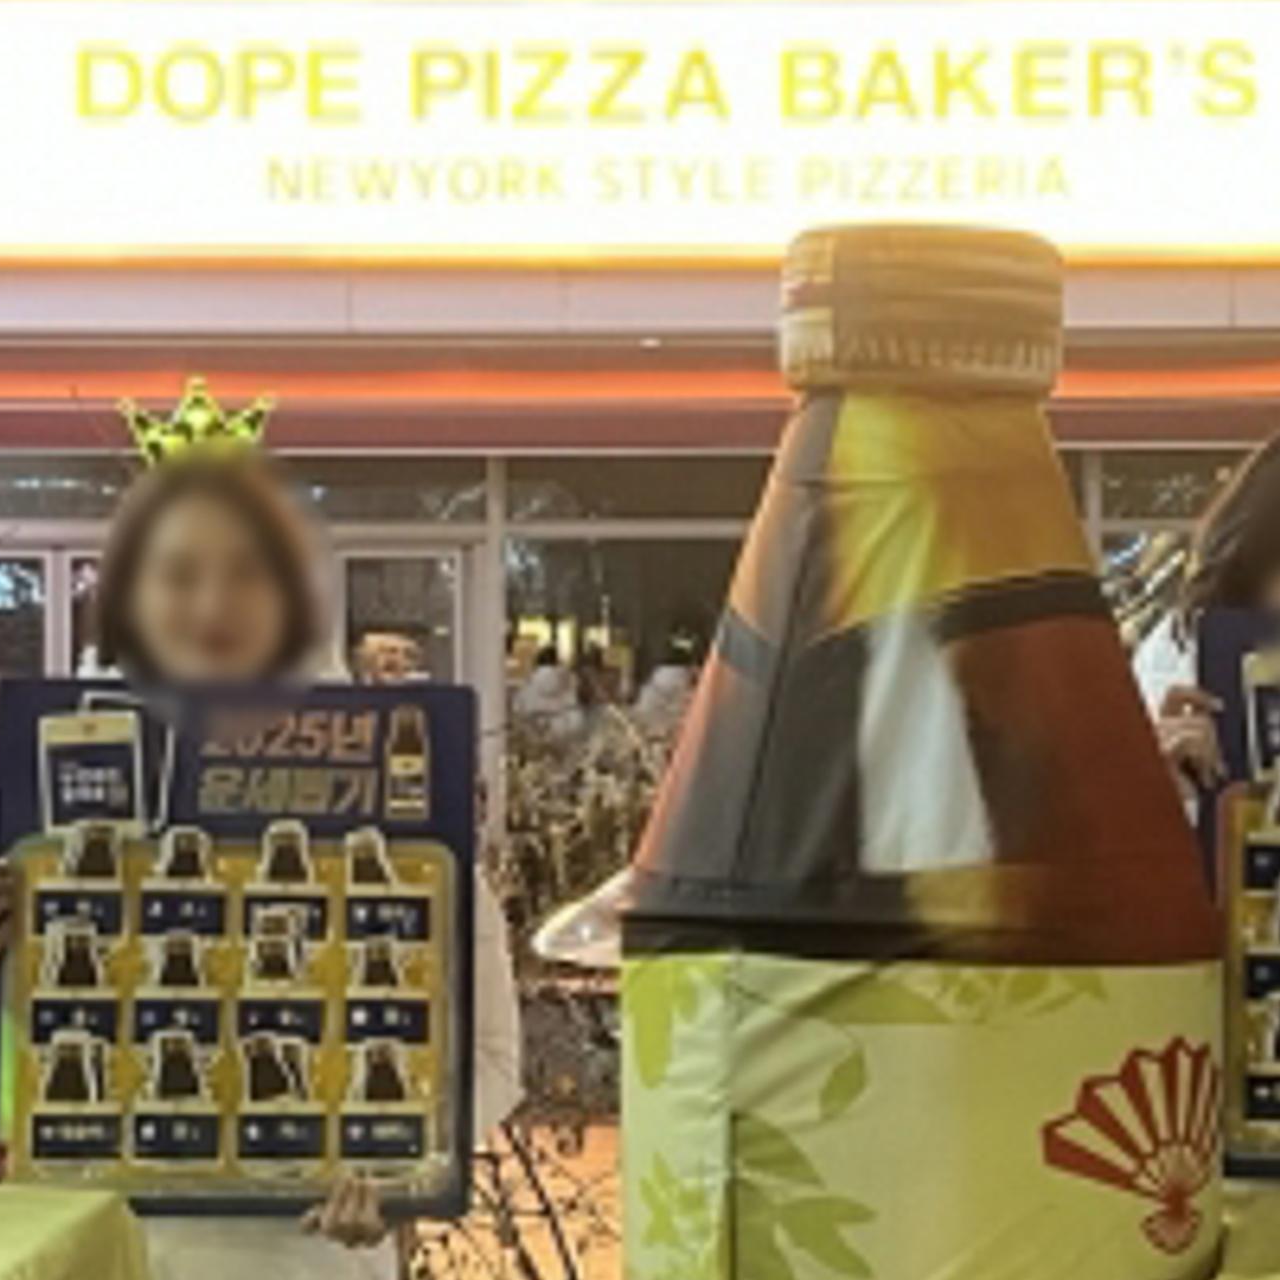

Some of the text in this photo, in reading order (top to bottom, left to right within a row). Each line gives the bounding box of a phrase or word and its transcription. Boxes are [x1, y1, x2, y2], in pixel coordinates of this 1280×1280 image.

[74, 42, 1260, 124] DOPE PIZZA BAKER'S
[266, 156, 1073, 202] NEWYORK STYLE PIZZERIA
